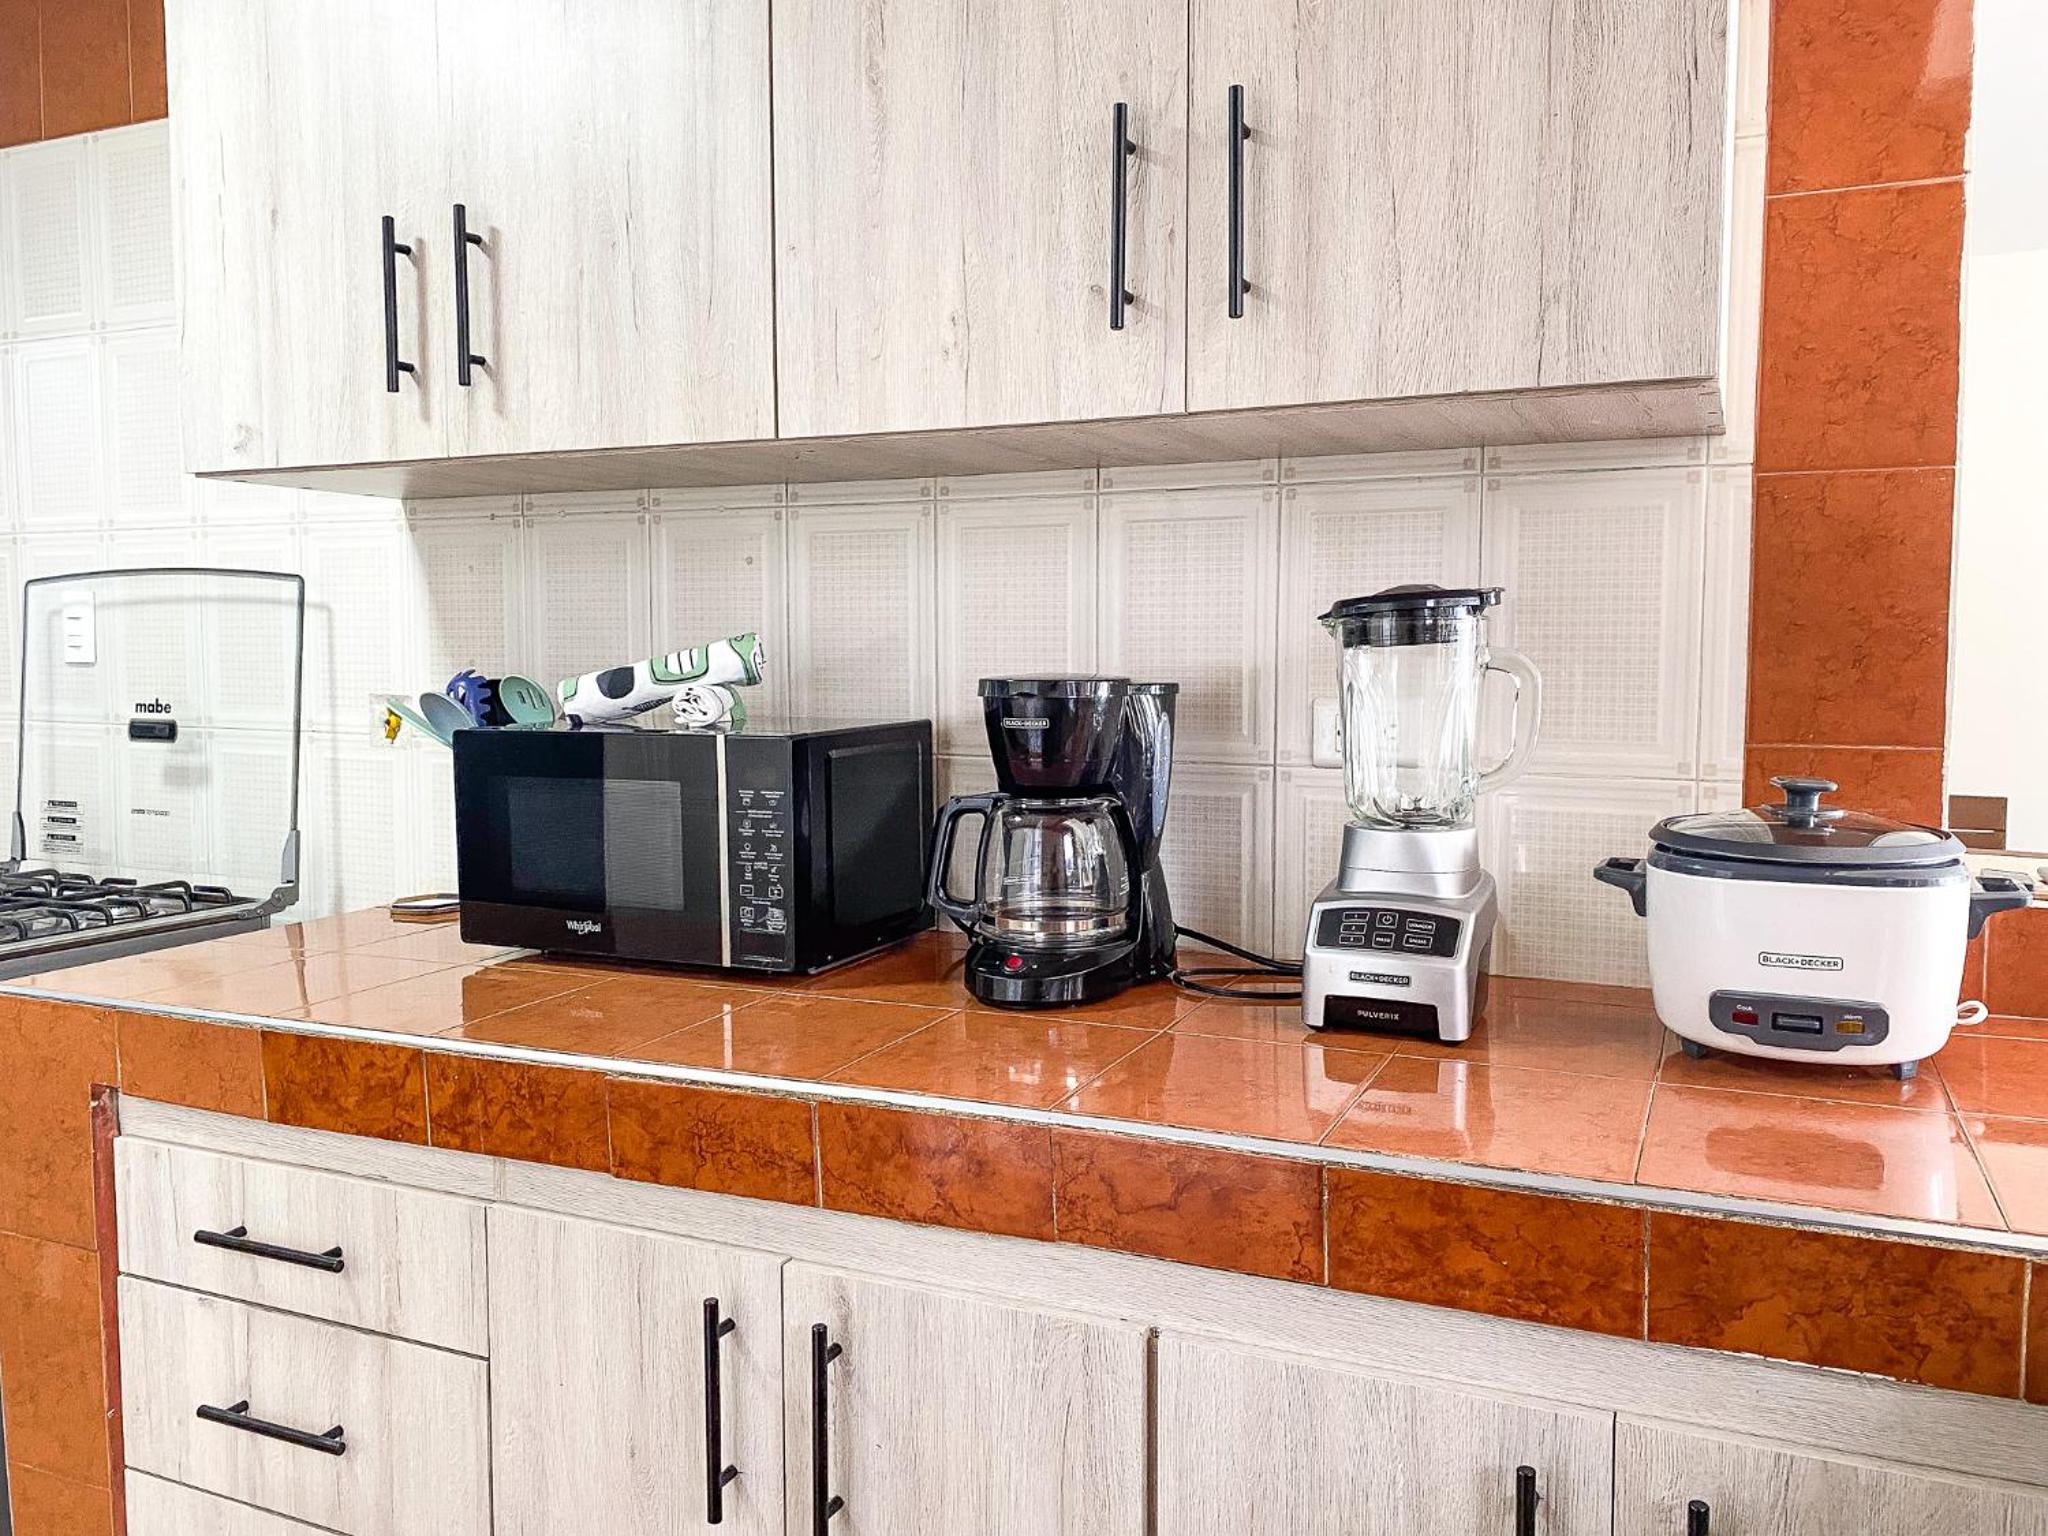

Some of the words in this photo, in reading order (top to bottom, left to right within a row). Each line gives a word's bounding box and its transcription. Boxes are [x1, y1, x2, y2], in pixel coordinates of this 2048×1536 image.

[135, 698, 172, 714] mabe
[1761, 955, 1840, 968] BLACK+DECKER
[1357, 1009, 1400, 1021] PULVERIX
